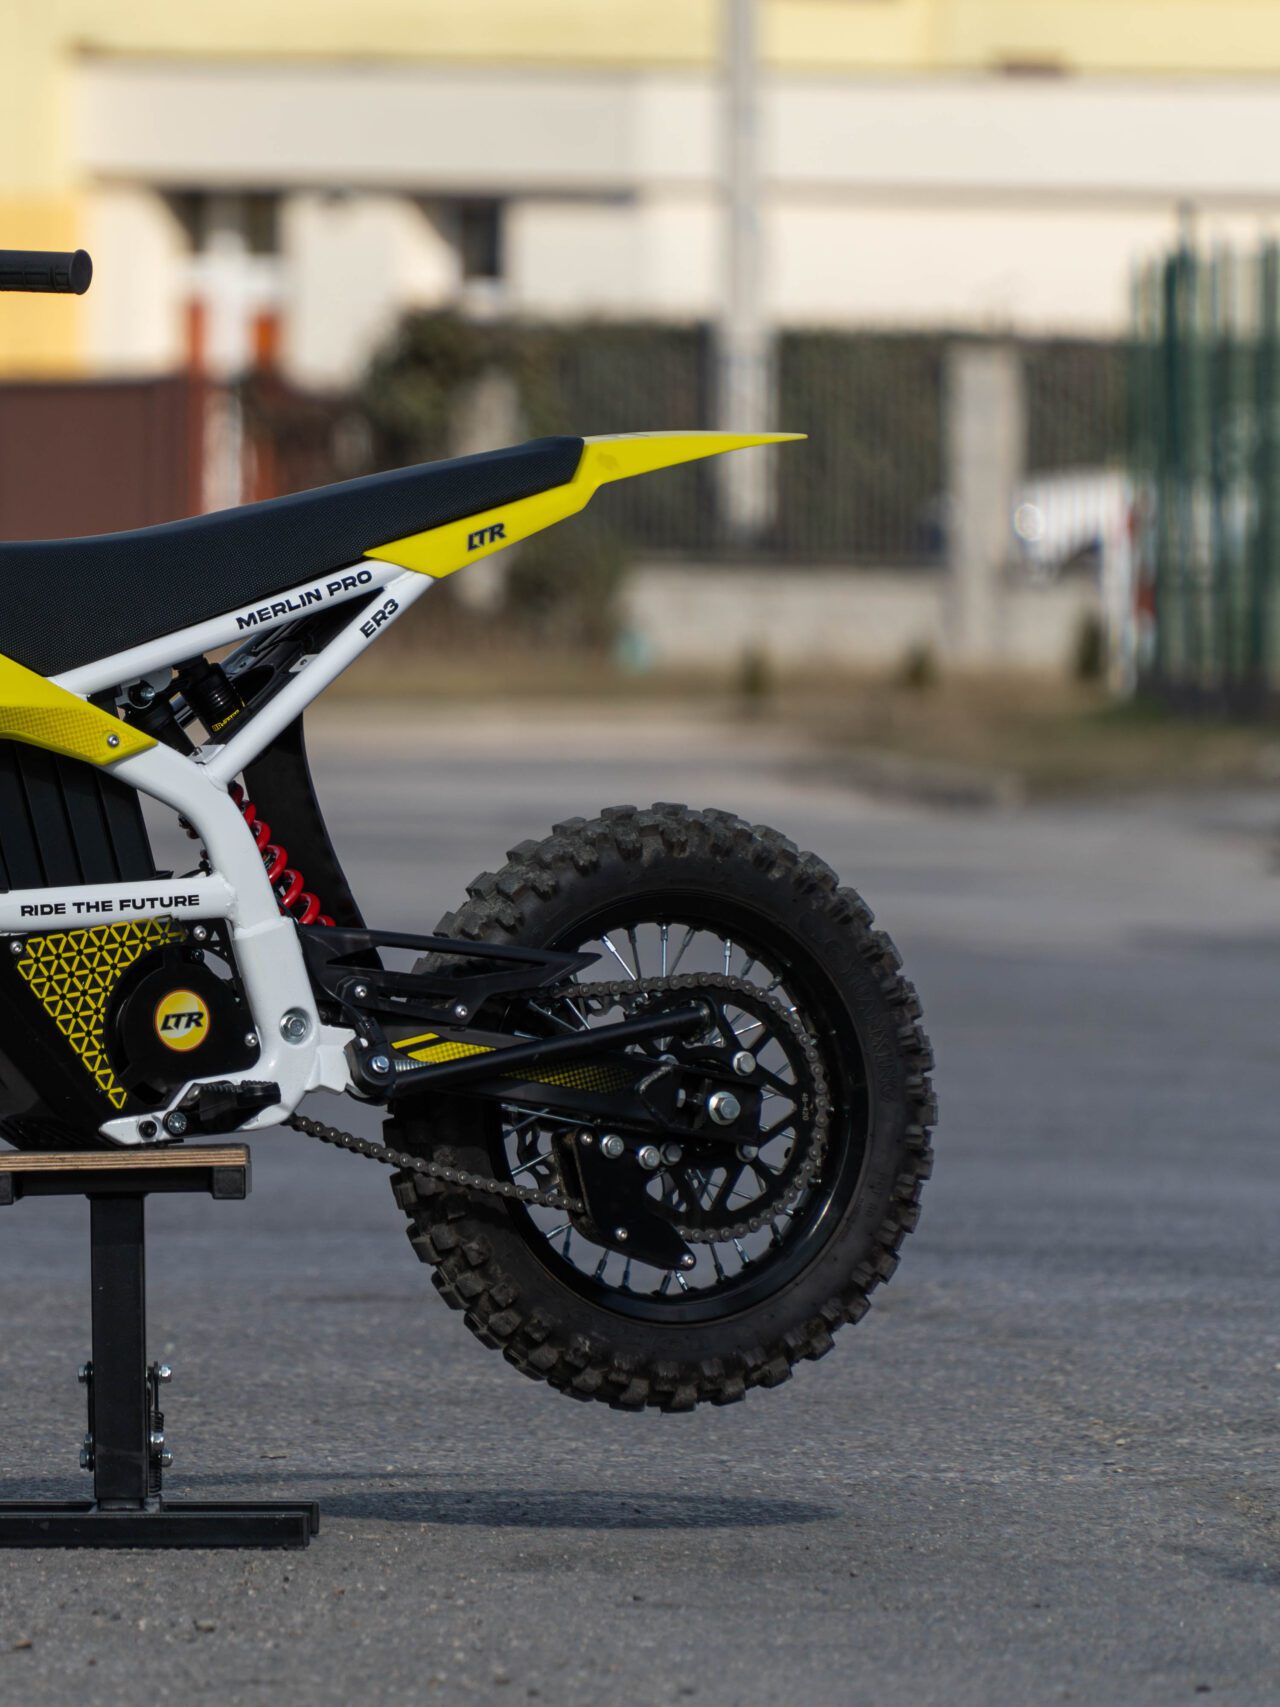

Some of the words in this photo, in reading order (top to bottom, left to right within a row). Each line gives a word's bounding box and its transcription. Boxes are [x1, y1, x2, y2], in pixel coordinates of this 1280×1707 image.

[466, 522, 507, 552] LTR
[235, 588, 323, 630] MERLIN
[326, 570, 373, 596] PRO
[359, 598, 400, 639] ER3
[20, 903, 66, 917] RIDE
[72, 900, 113, 914] THE
[119, 894, 200, 911] FUTURE
[160, 1011, 204, 1031] LTR
